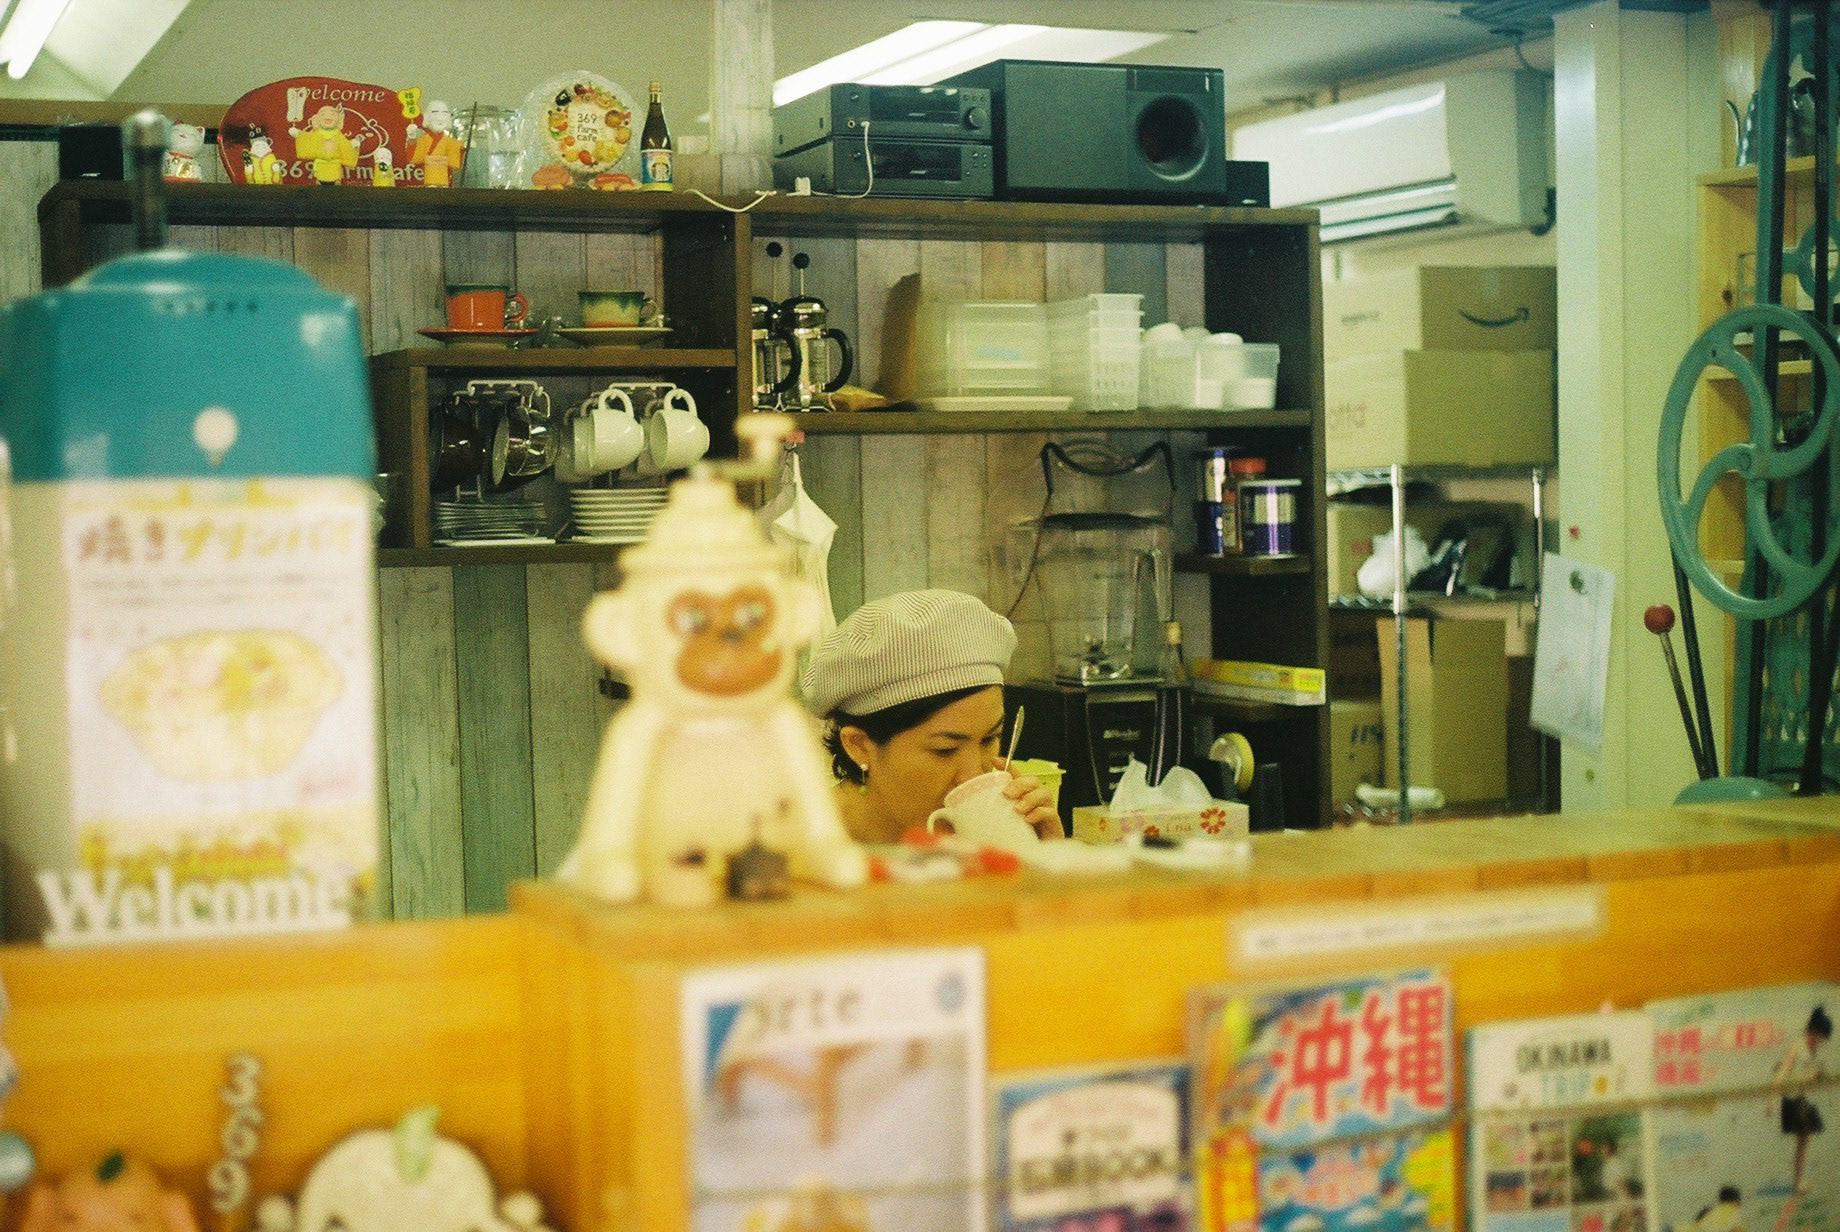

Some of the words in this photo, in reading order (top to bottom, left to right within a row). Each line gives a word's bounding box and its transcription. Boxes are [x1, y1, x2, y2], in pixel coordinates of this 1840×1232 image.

[577, 112, 598, 123] 369
[577, 124, 598, 134] farm
[576, 133, 598, 142] cafe
[393, 163, 425, 181] afe
[38, 866, 351, 944] Welcome
[1261, 986, 1448, 1127] 沖縄
[1516, 1039, 1613, 1074] OKINAWA
[208, 1053, 263, 1213] 369
